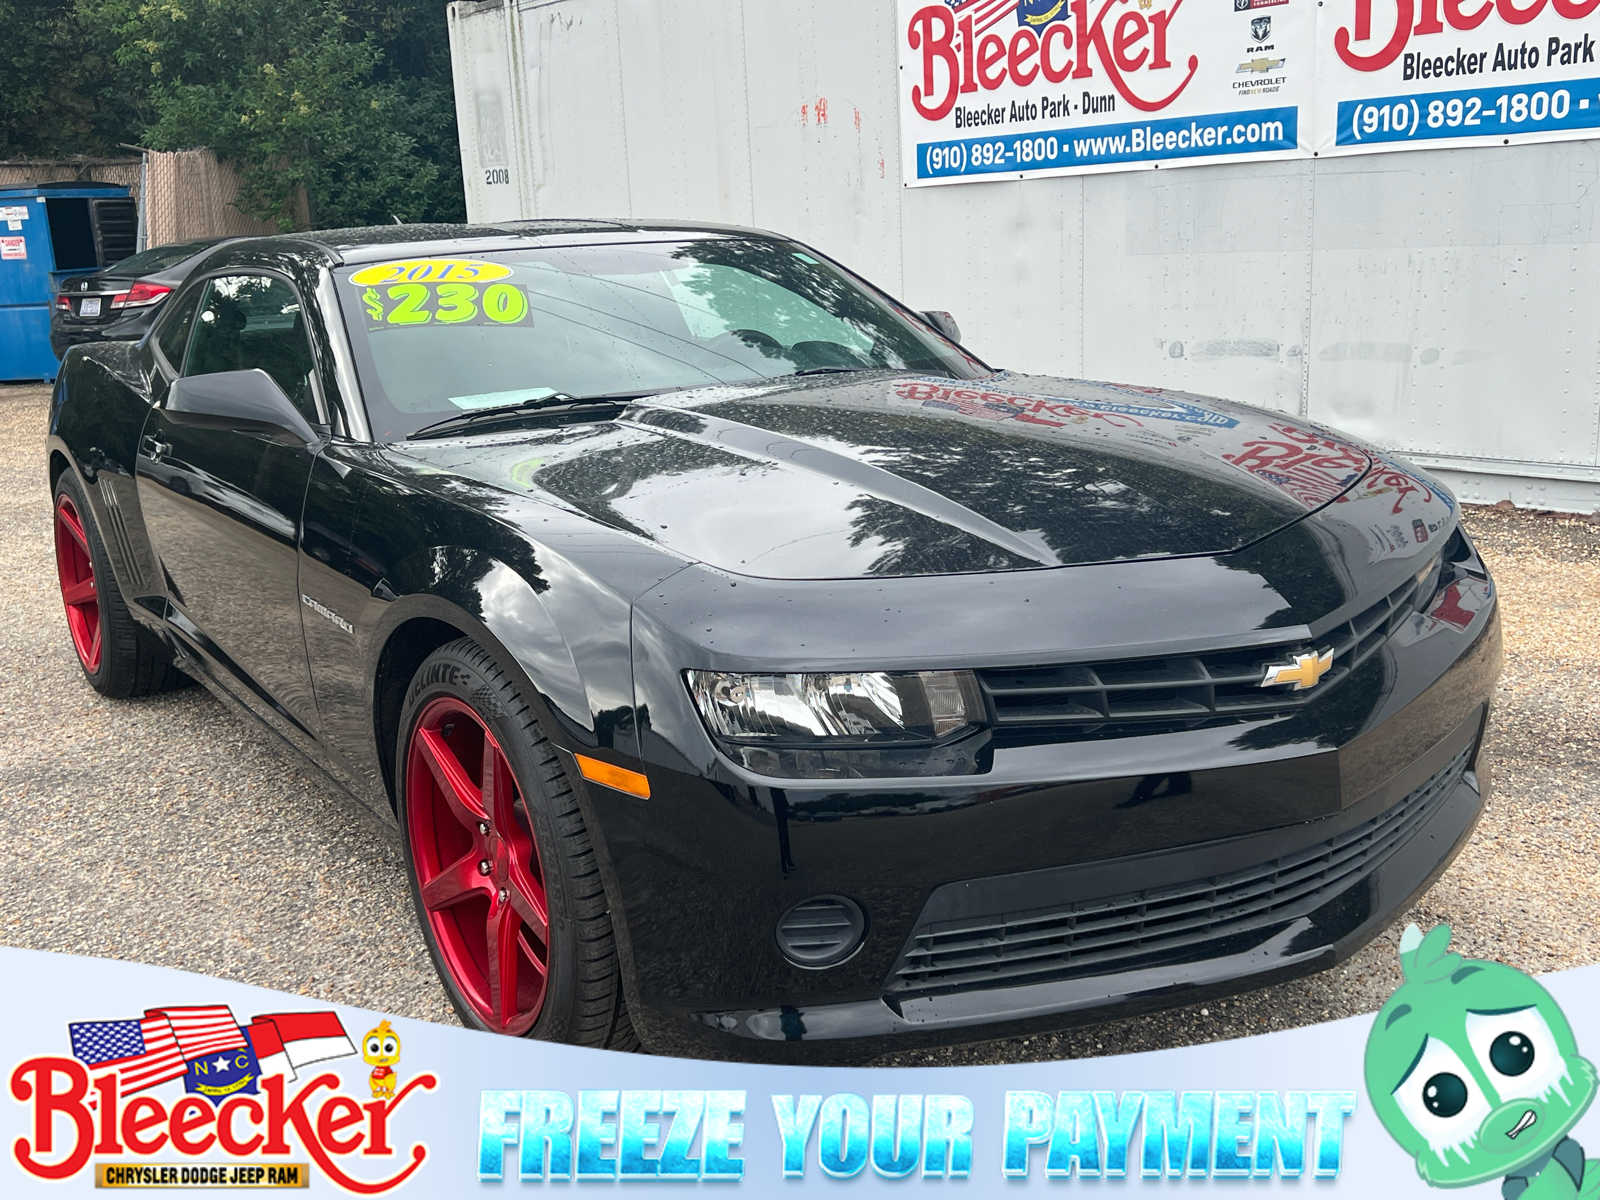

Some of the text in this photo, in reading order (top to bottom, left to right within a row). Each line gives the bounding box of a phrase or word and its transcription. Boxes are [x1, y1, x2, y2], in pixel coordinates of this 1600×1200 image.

[908, 0, 1198, 121] Bleecker
[1246, 44, 1275, 53] RAM
[1402, 47, 1488, 81] Bleecker
[1491, 41, 1540, 72] Auto
[1546, 33, 1595, 67] Park
[1232, 76, 1287, 89] CHEVROLET
[955, 91, 1115, 128] Bleecker Auto Park Dunn
[1352, 89, 1571, 140] (910) 892-1800
[925, 118, 1284, 175] (910) 892-1800 www.Bleecker.com
[485, 168, 510, 185] 2008
[381, 263, 485, 283] 2015
[362, 283, 528, 326] $230
